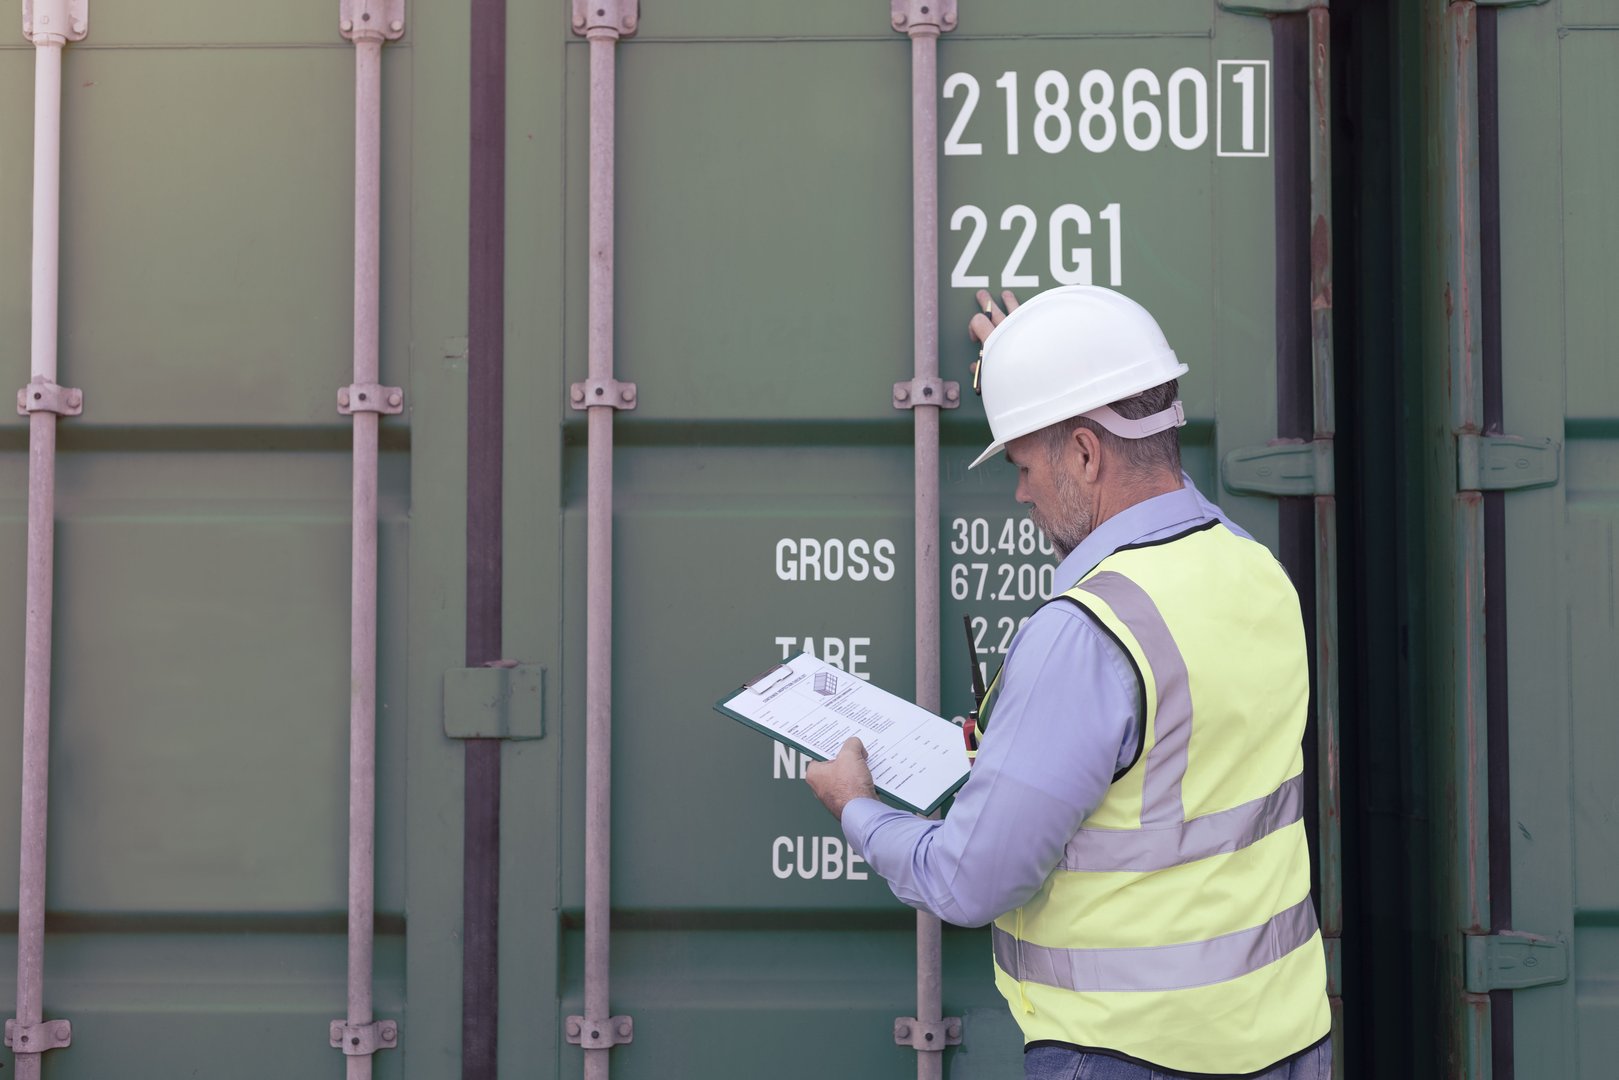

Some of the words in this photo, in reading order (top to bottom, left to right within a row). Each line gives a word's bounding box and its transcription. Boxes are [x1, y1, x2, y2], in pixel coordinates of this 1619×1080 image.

[944, 67, 1208, 155] 218860
[1233, 67, 1254, 150] 1
[950, 203, 1122, 287] 22G1
[776, 538, 895, 581] GROSS
[772, 835, 869, 881] CUBE
